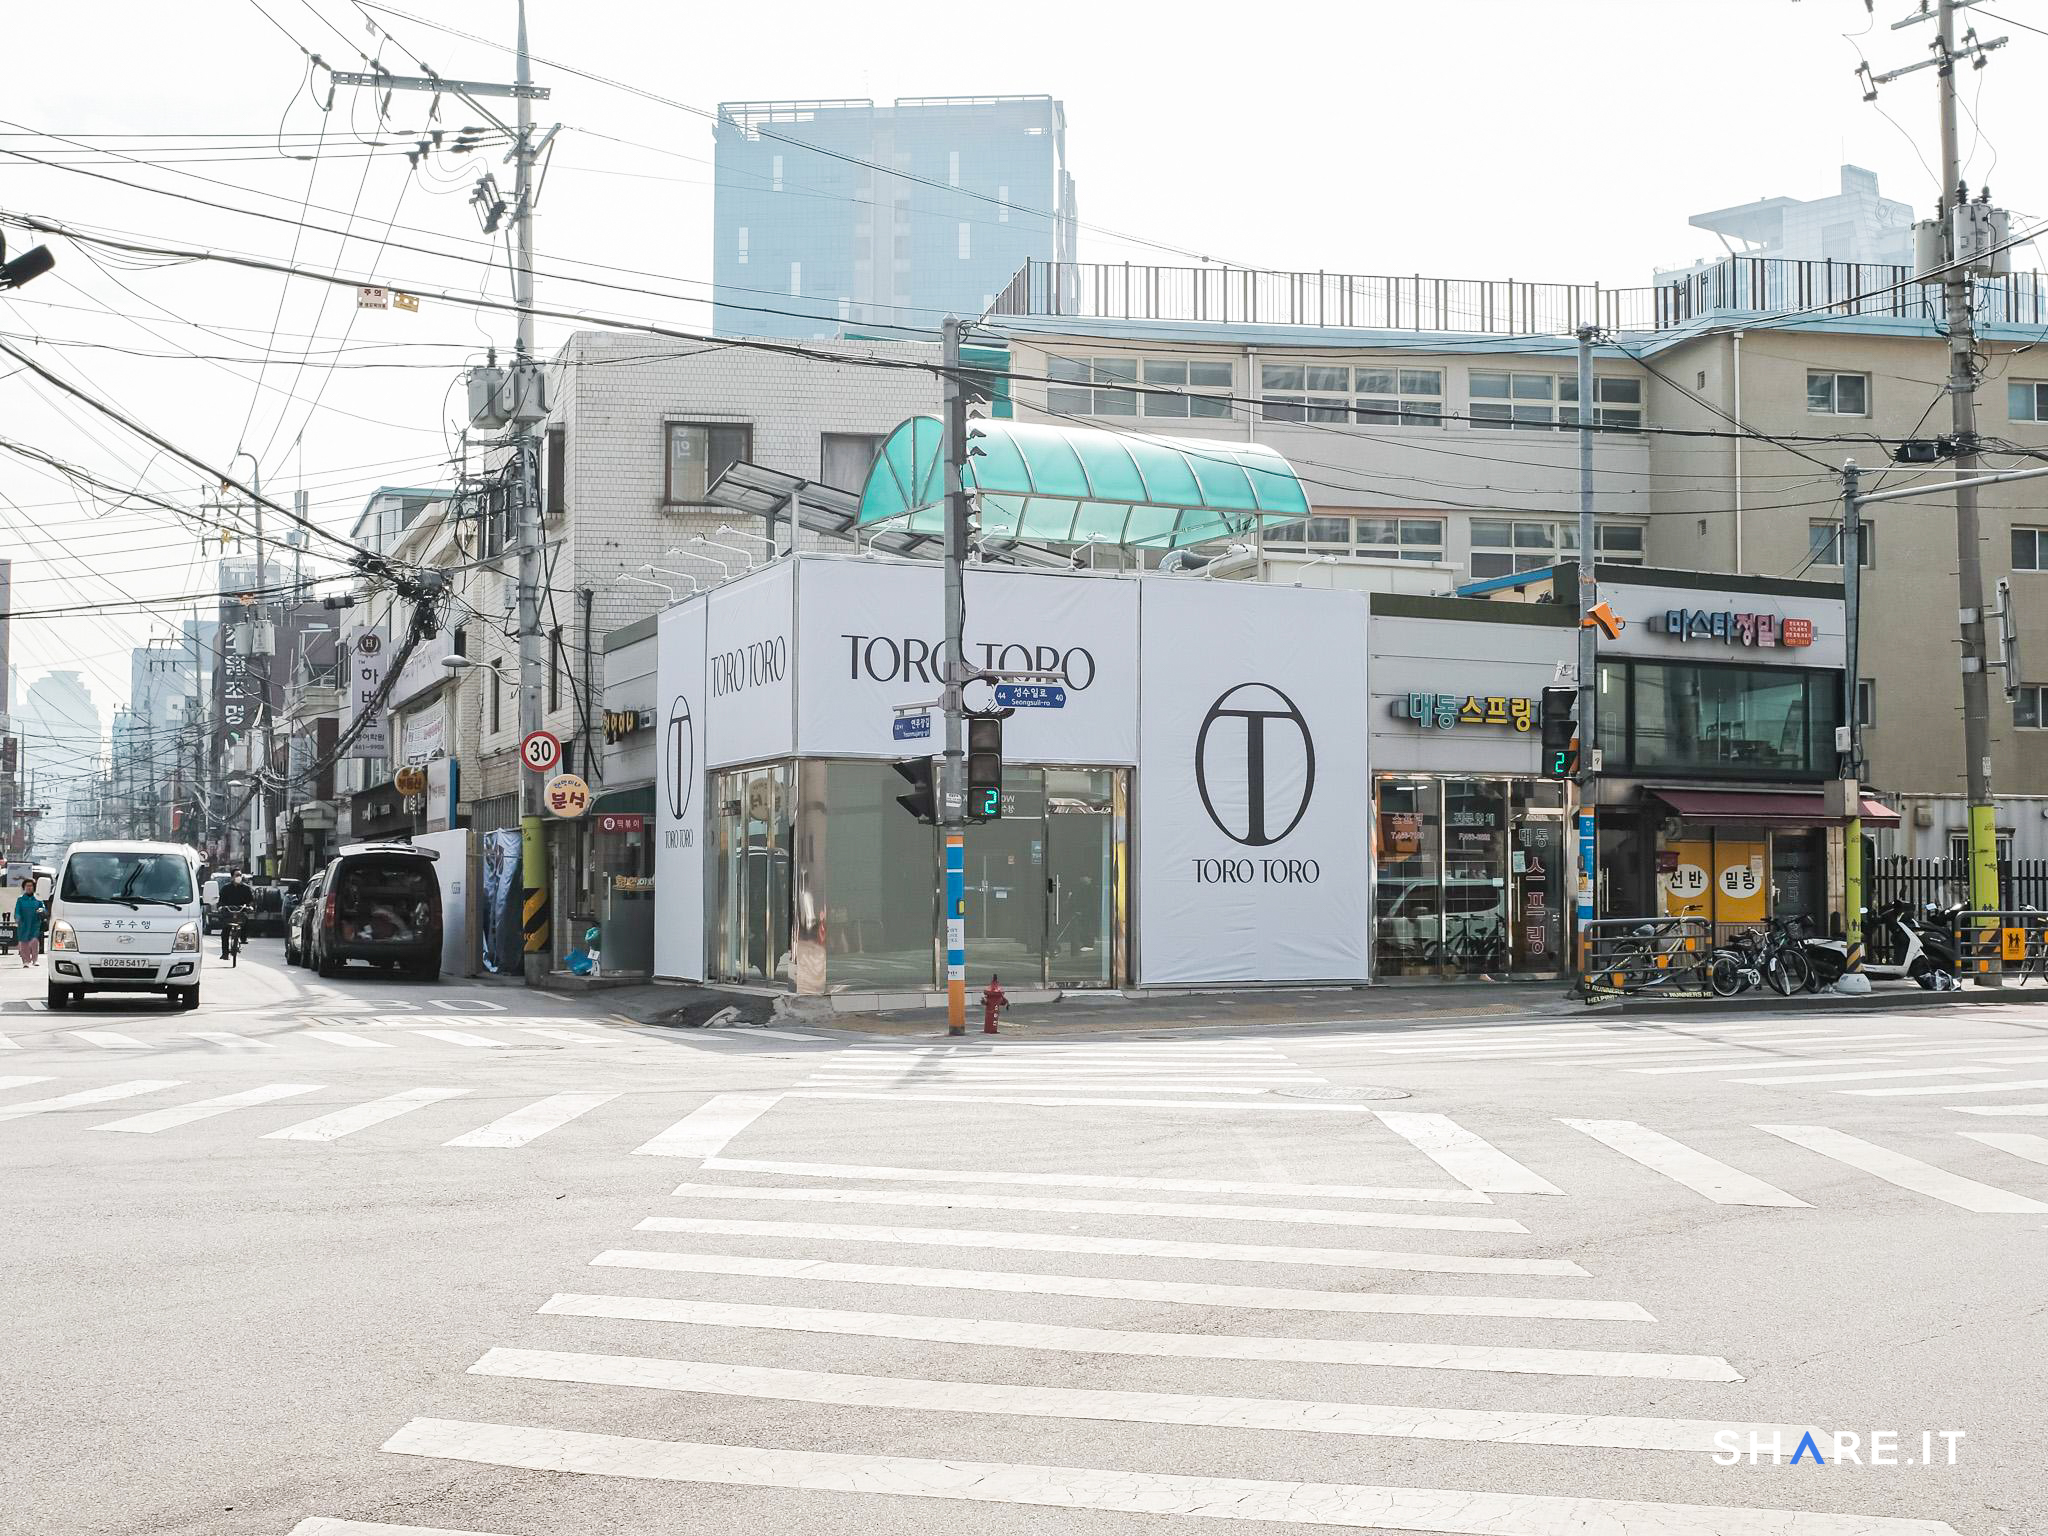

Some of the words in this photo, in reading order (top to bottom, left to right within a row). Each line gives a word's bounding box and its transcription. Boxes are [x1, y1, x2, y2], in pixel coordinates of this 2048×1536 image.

[1666, 608, 1776, 648] 마스타정밀
[711, 648, 745, 698] TORO
[747, 635, 786, 688] TORO
[976, 643, 1096, 691] TORO
[997, 692, 1006, 700] 44
[1012, 698, 1051, 707] Seongsuil-ro
[1013, 687, 1048, 698] 성수일로
[1055, 694, 1064, 702] 40
[1408, 692, 1532, 733] 대동스프링
[530, 740, 551, 762] 30
[1554, 752, 1565, 774] 2
[551, 791, 585, 810] 분식
[984, 789, 997, 814] 2
[665, 830, 679, 849] TORO
[679, 829, 693, 848] TORO
[1519, 828, 1549, 847] 대동
[1192, 858, 1255, 884] TORO
[1258, 858, 1320, 884] TORO
[1670, 870, 1703, 889] 선반
[1725, 871, 1755, 890] 밀링
[1525, 856, 1546, 955] 스프링
